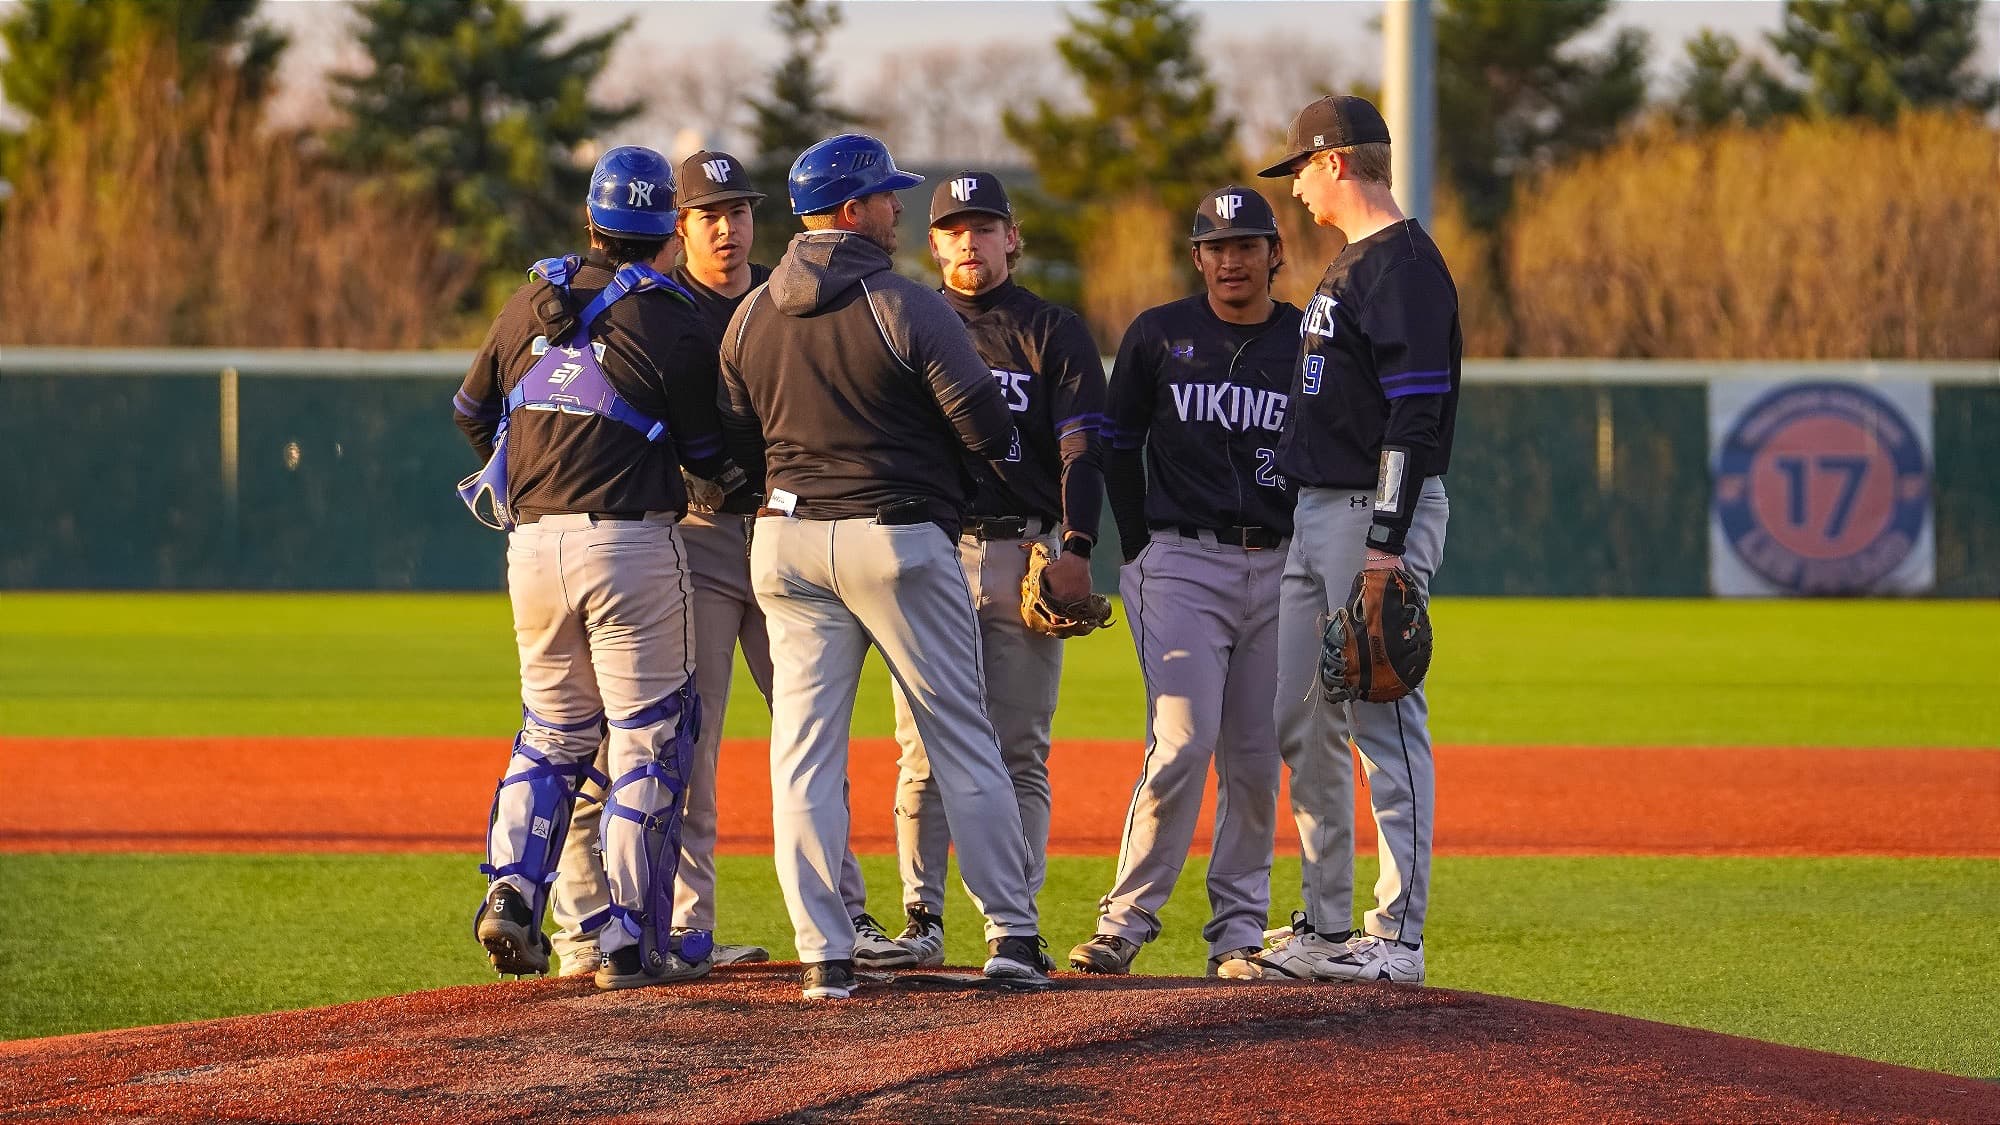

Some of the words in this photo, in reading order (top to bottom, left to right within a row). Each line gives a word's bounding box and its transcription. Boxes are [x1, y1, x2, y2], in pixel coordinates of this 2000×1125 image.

[702, 159, 731, 184] NP
[950, 177, 979, 202] NP
[1215, 194, 1243, 220] NP
[1303, 353, 1325, 395] 9
[1169, 382, 1289, 432] VIKING
[1775, 455, 1871, 541] 17
